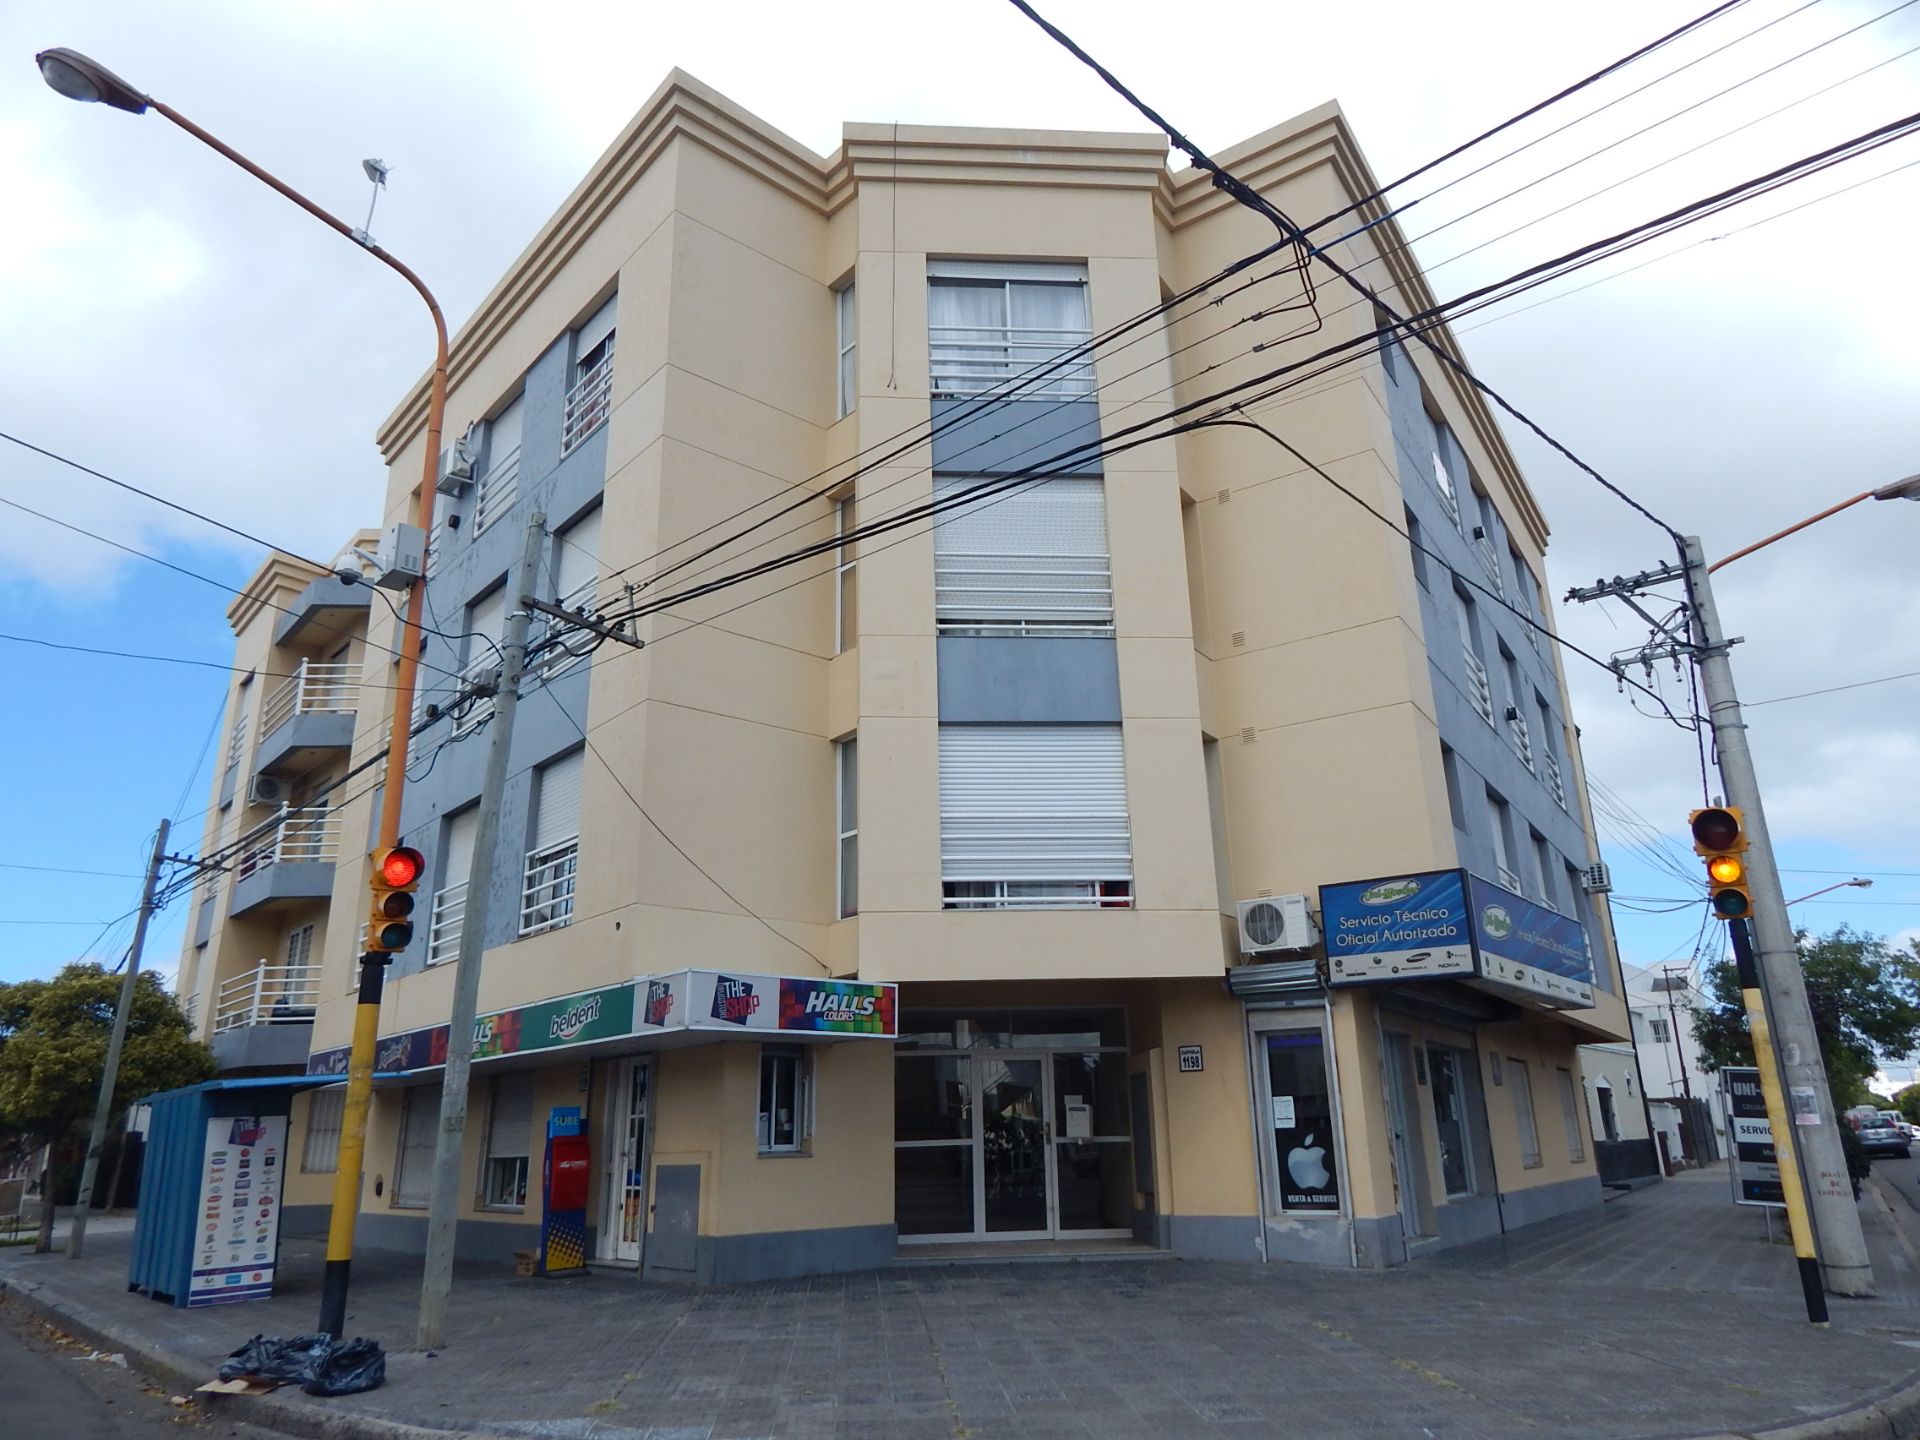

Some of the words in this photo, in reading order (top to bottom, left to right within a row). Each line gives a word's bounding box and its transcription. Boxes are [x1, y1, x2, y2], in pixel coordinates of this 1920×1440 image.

[1340, 915, 1390, 929] Servicio
[1394, 908, 1448, 923] Técnico
[1336, 932, 1378, 947] Oficial
[1383, 924, 1457, 942] Autorizado
[651, 982, 668, 1003] THE
[723, 980, 747, 998] THE
[805, 991, 876, 1016] HALLS
[550, 996, 601, 1038] beldent
[823, 1011, 855, 1021] COLORS
[472, 1021, 494, 1043] LLS
[1183, 1056, 1200, 1069] 1198
[1733, 1082, 1760, 1096] UNI-
[554, 1116, 578, 1127] SUBE
[1740, 1125, 1773, 1136] SERVIC
